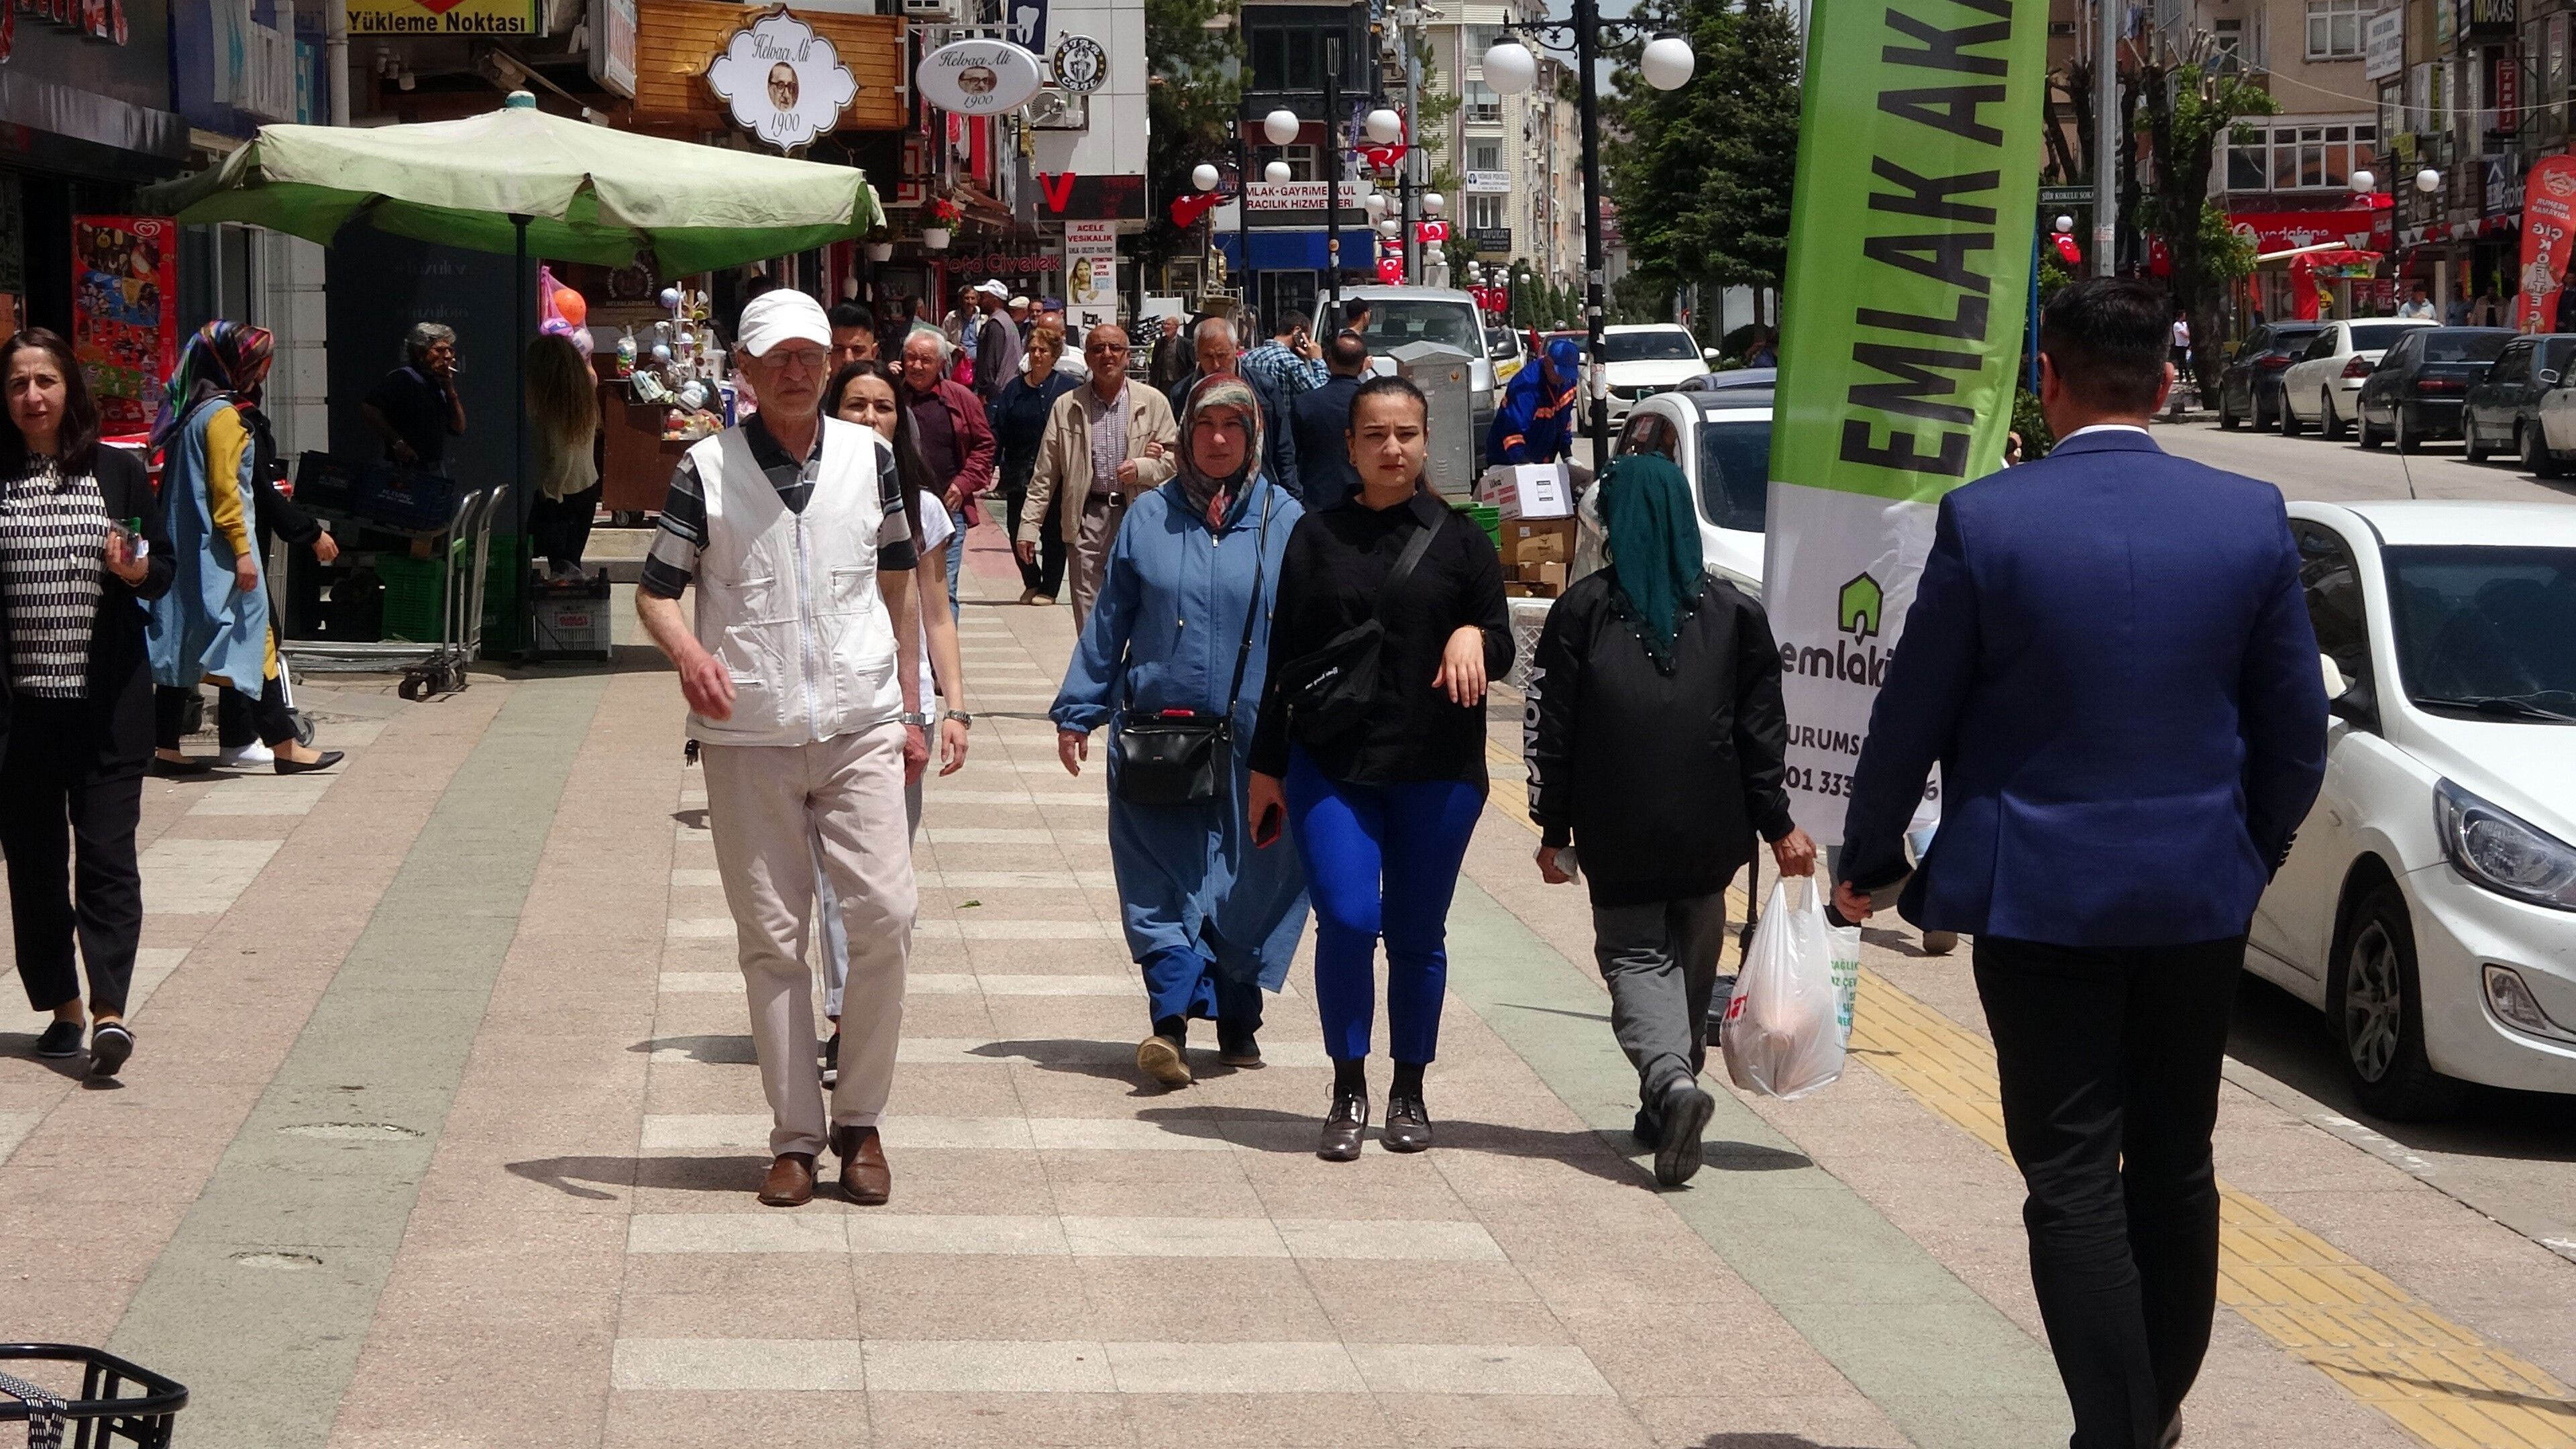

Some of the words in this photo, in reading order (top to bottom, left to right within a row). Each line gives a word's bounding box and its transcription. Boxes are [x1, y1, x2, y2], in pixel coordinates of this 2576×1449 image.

[347, 11, 438, 31] Yükleme
[446, 11, 525, 32] Noktası
[2474, 0, 2514, 22] MAKAS
[752, 34, 790, 61] Helvacı
[1063, 39, 1100, 55] STAR
[939, 50, 987, 67] Helvacı
[1062, 76, 1097, 91] CAFE
[1877, 0, 2012, 147] AK
[964, 95, 993, 108] 1900
[771, 113, 800, 137] 1900
[1246, 199, 1287, 209] RACILIK
[1077, 224, 1105, 232] ACELE
[987, 252, 1062, 272] Civelek
[1839, 154, 2000, 477] EMLAK
[1523, 666, 1547, 814] MONCE
[1786, 724, 1860, 756] URUMS
[1785, 765, 1813, 792] 01
